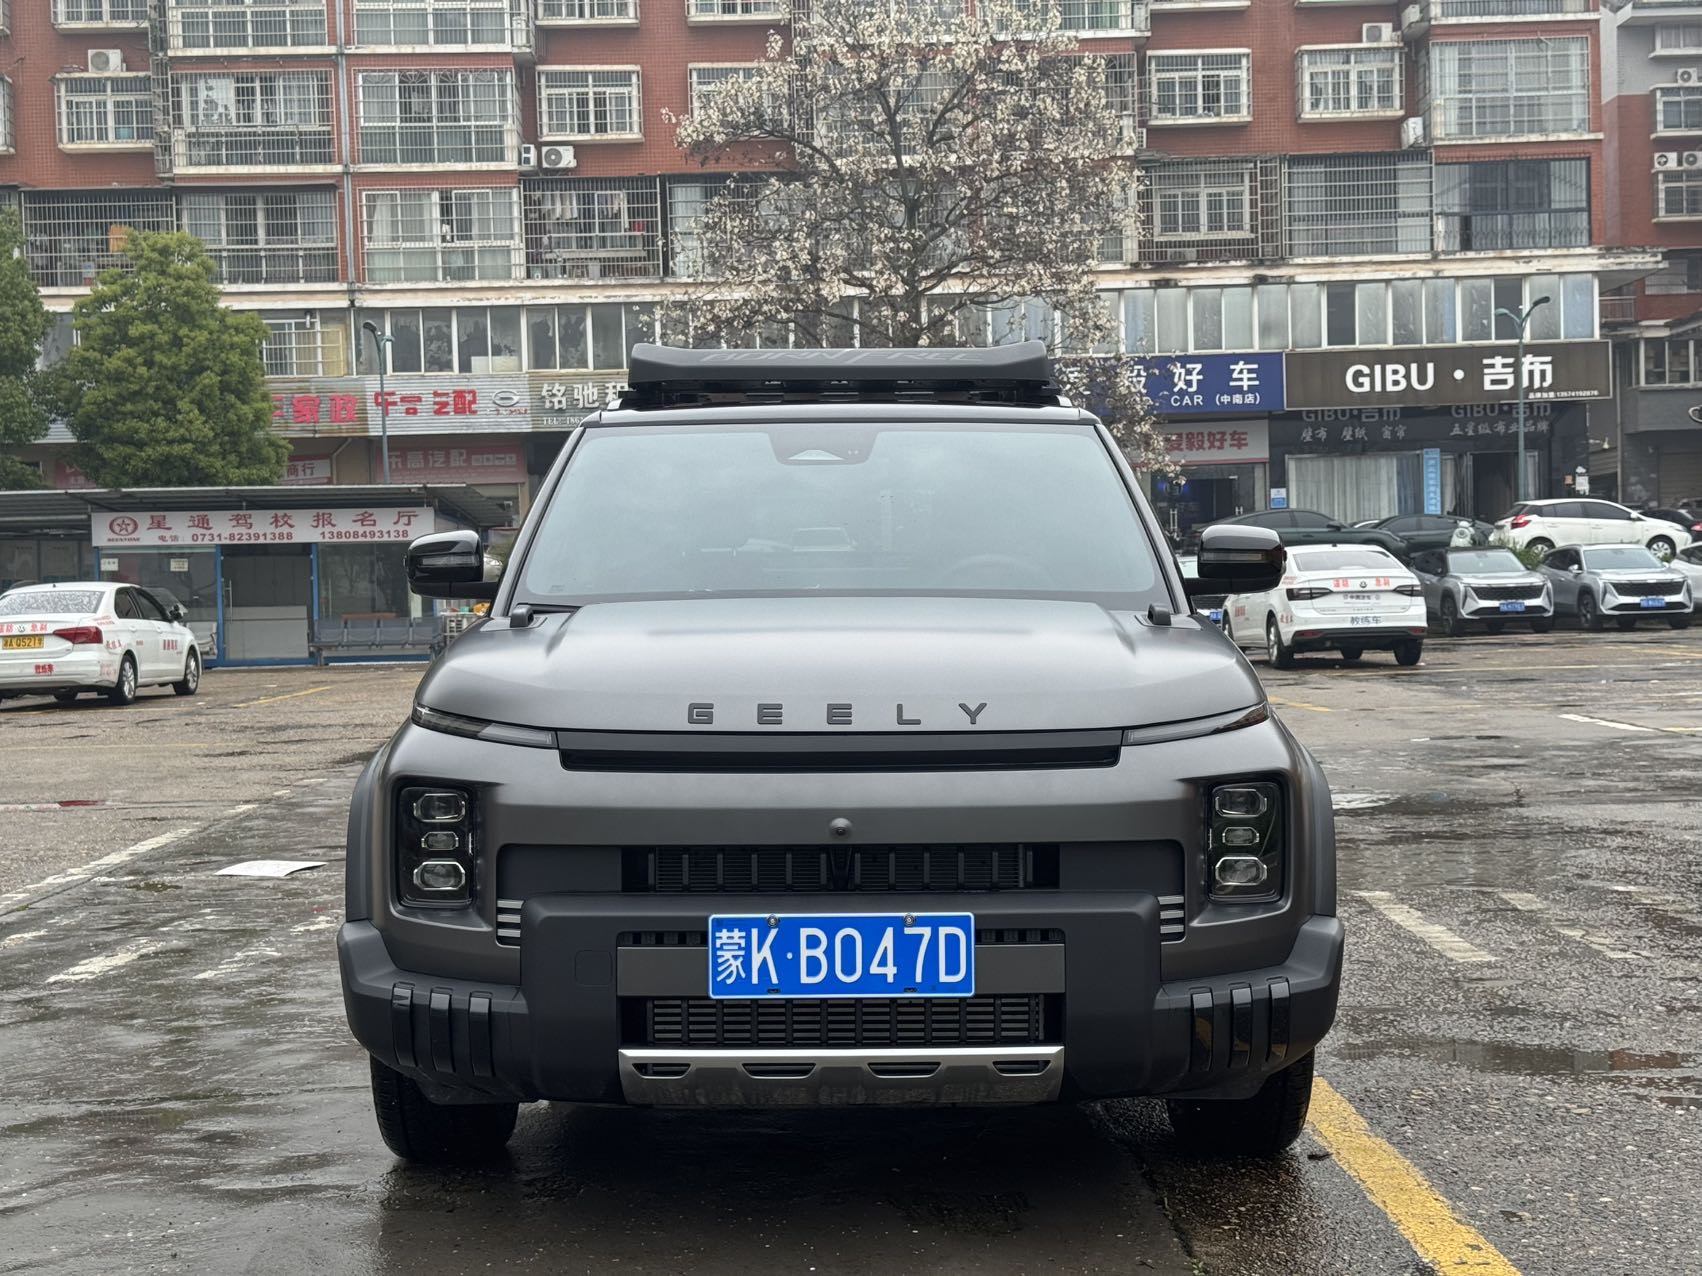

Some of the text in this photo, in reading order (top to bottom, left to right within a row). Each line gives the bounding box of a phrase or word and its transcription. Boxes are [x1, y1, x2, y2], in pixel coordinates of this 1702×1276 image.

[1345, 362, 1436, 393] GIBU
[1482, 354, 1553, 391] 吉布
[1171, 395, 1203, 406] CAR
[1215, 393, 1261, 405] (中南店)
[147, 510, 419, 531] 星通驾校报名厅
[191, 532, 294, 543] 0731-82391388
[320, 529, 409, 540] 13808493138
[687, 702, 988, 725] GEELY
[715, 926, 967, 985] 蒙K·B047D
